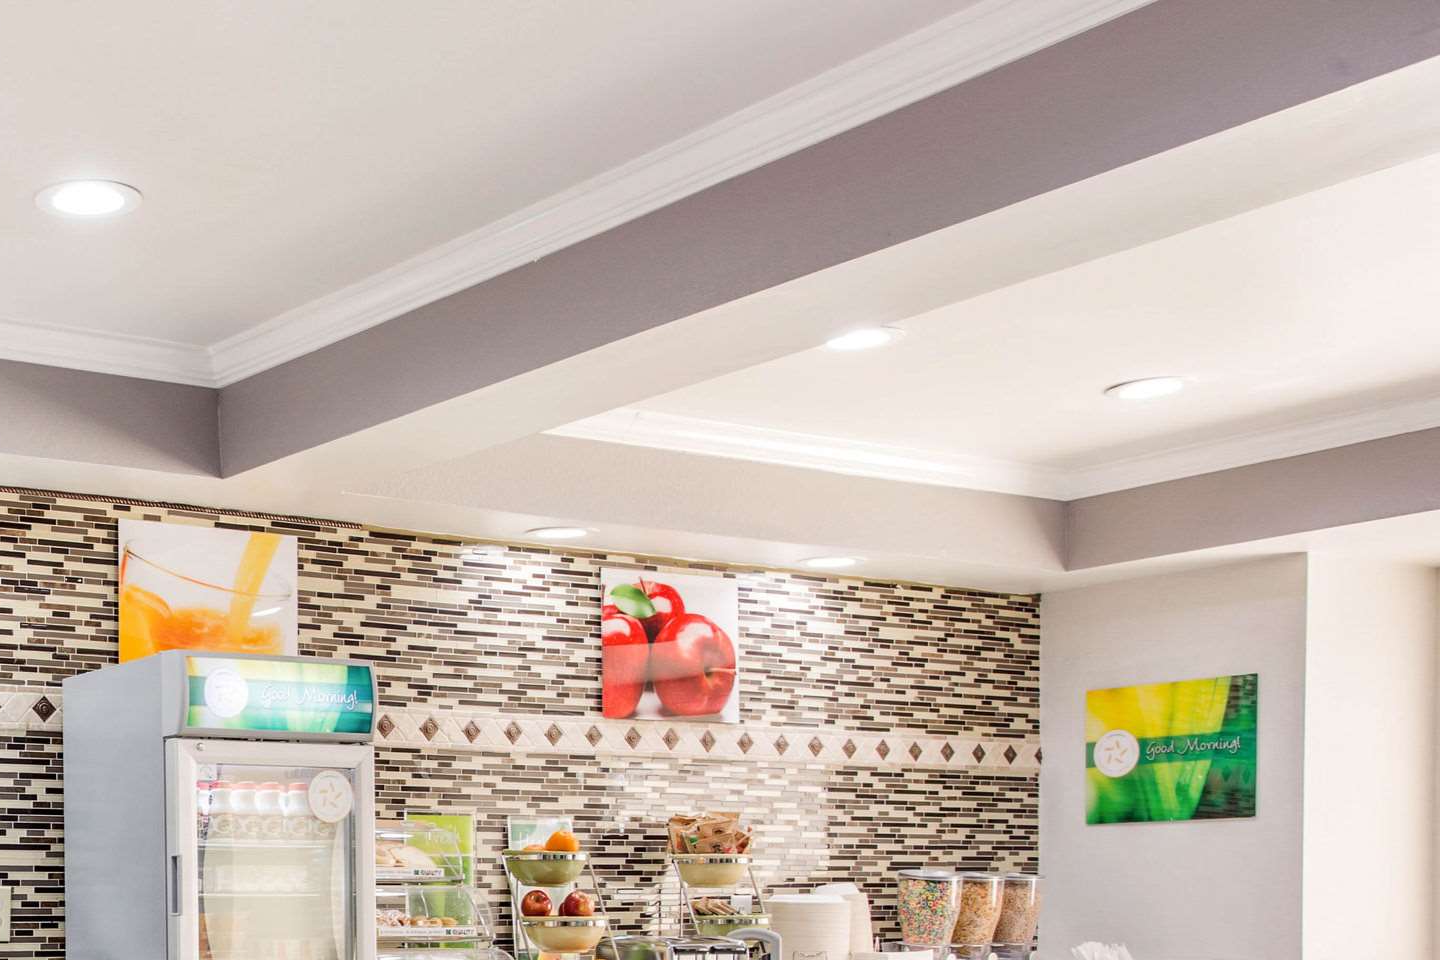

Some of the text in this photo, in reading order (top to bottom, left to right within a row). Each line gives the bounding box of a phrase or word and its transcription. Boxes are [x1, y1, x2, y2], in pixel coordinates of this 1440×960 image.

[296, 686, 359, 710] Morning!
[1146, 735, 1241, 760] Good Morning!
